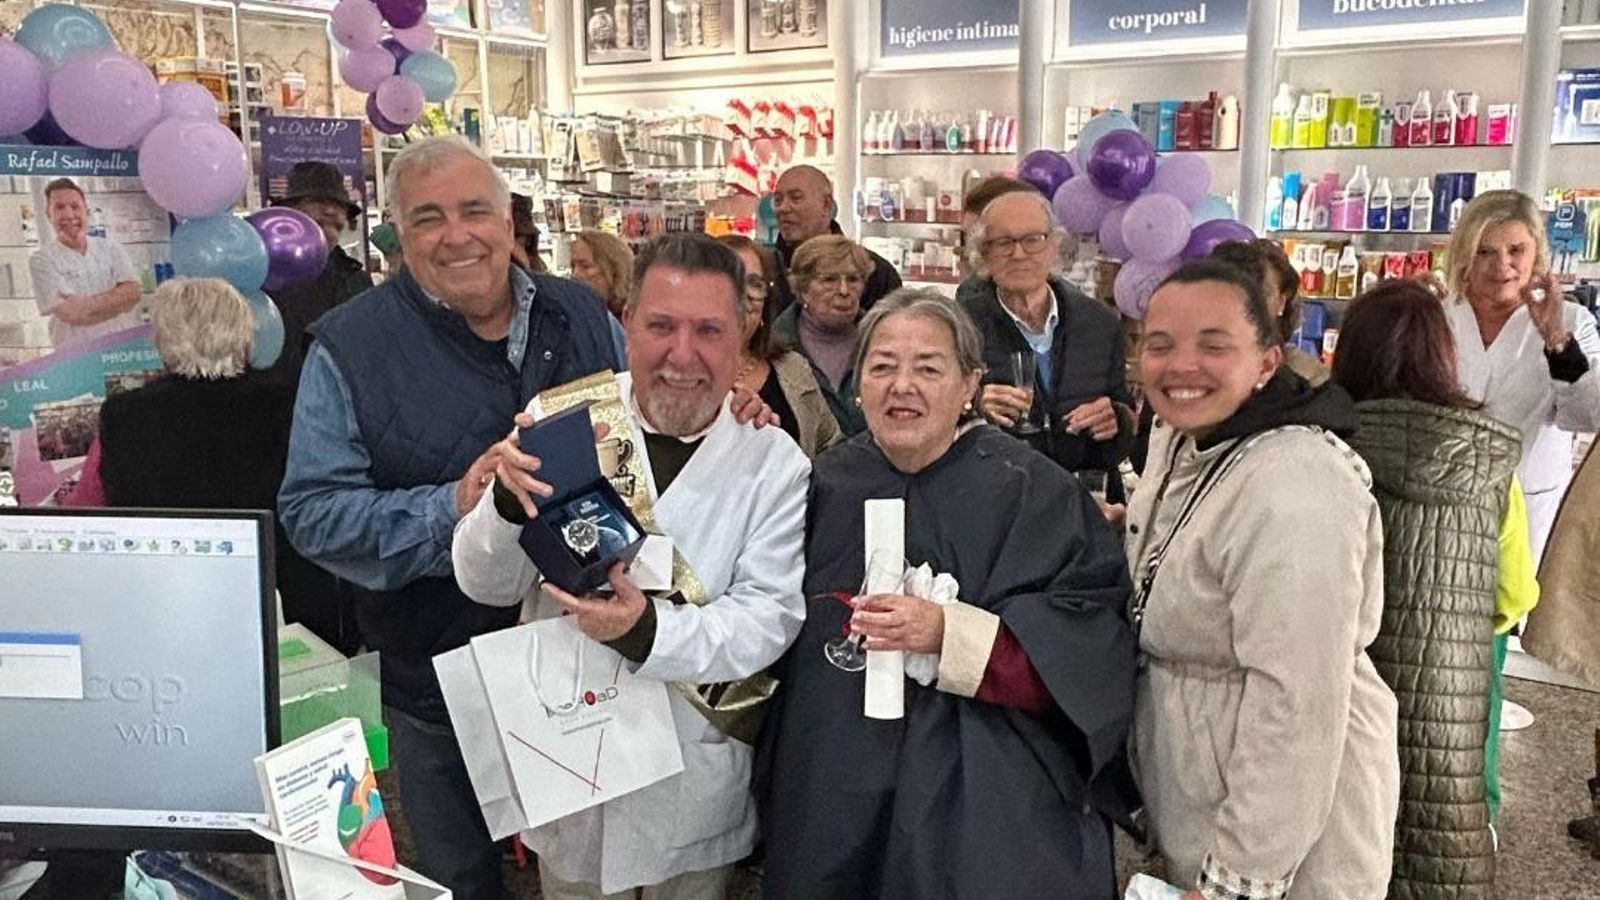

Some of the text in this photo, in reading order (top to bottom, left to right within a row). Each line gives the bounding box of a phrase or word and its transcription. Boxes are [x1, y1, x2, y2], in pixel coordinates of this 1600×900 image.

[1108, 3, 1206, 34] corporal
[889, 25, 954, 48] higiene
[8, 150, 129, 174] Rafael Sampallo
[13, 379, 49, 392] LEAL
[113, 717, 190, 746] win
